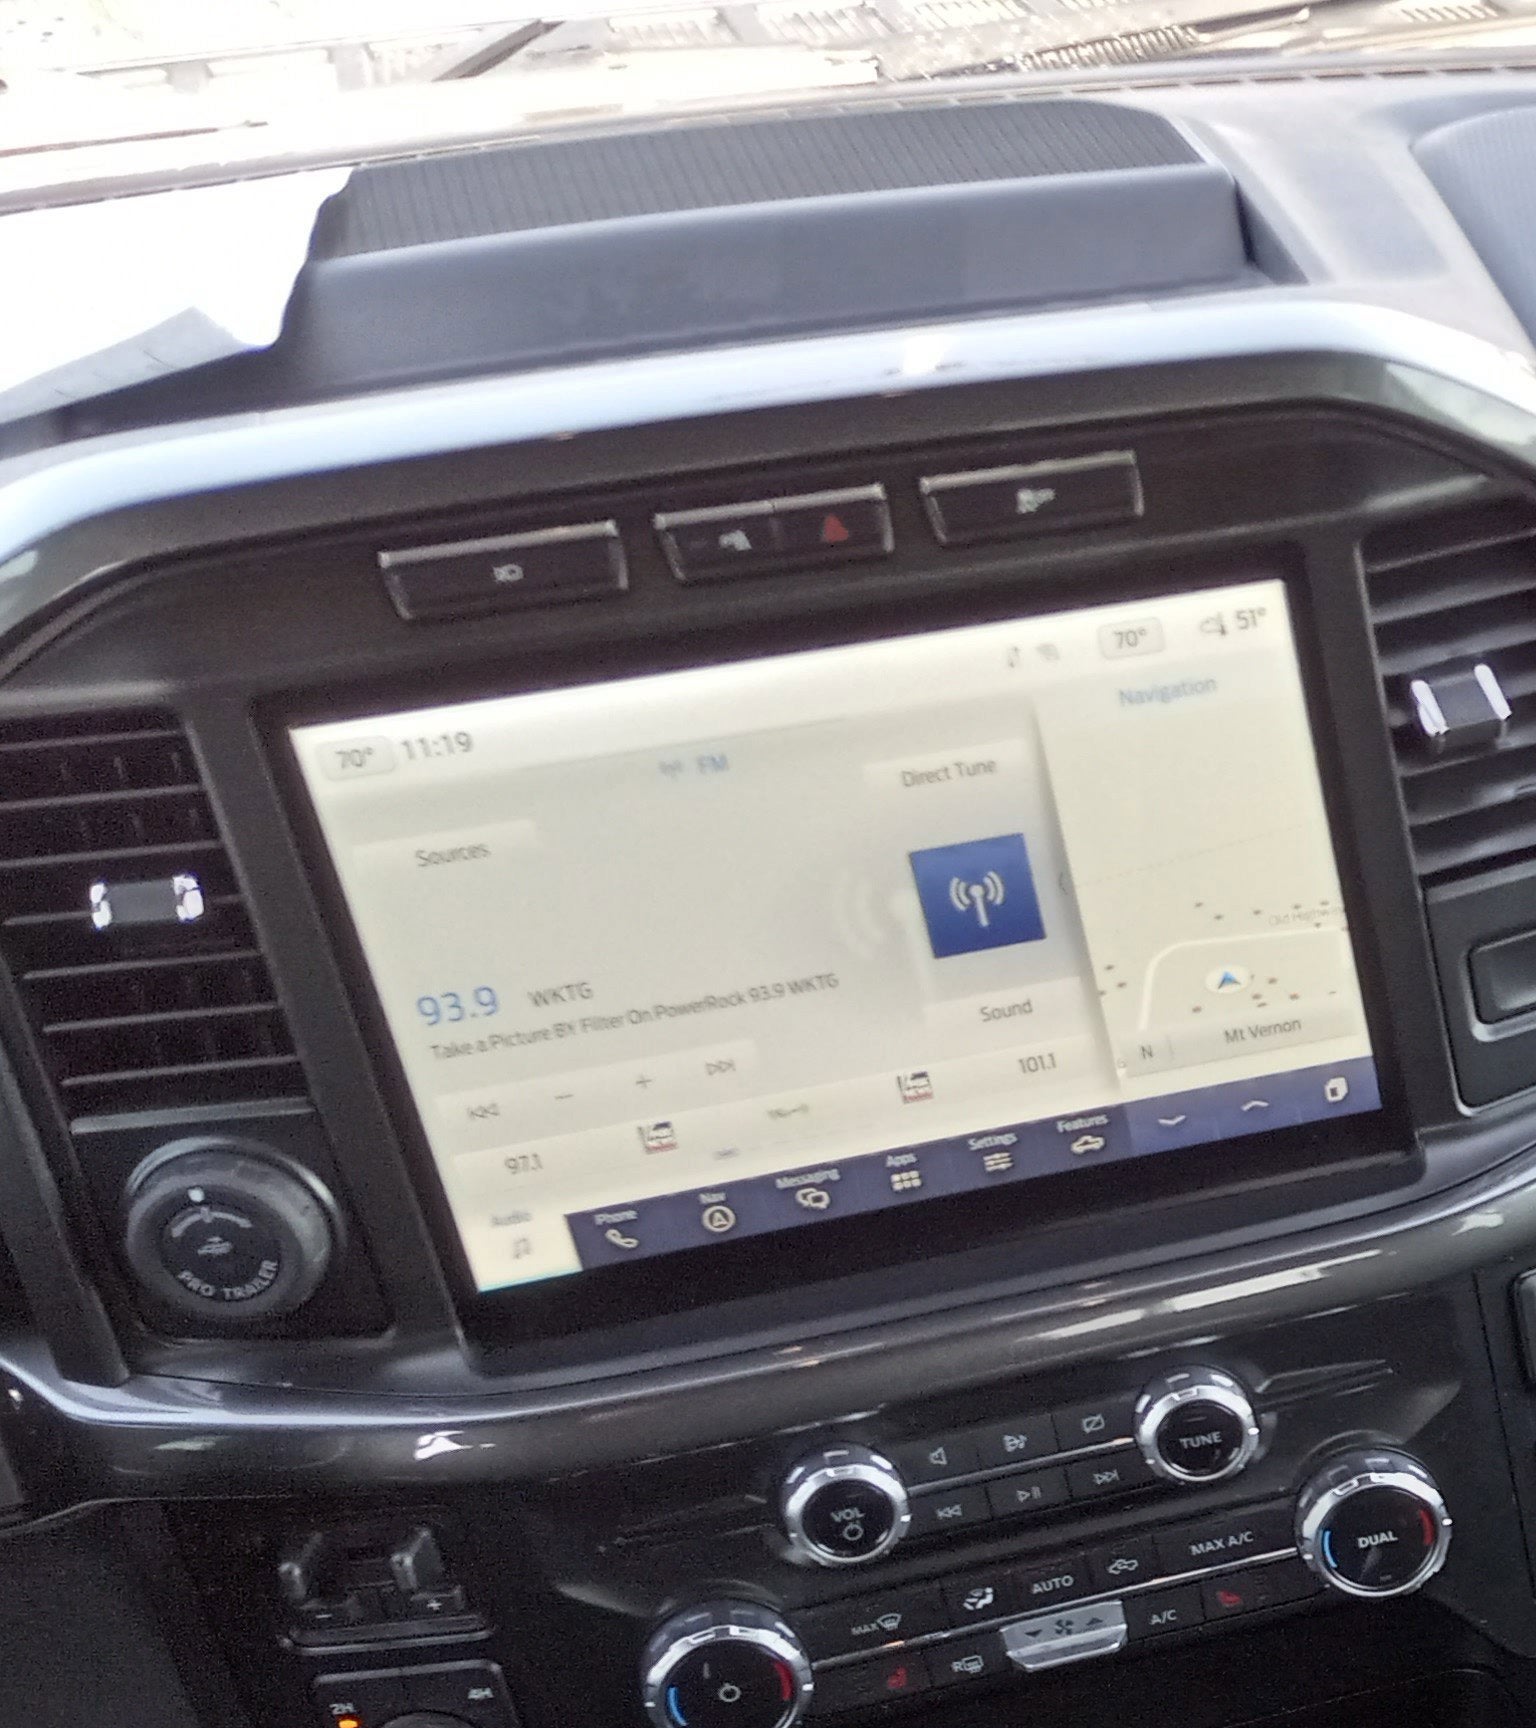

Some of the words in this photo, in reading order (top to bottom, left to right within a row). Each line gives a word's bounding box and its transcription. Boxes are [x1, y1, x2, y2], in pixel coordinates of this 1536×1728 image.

[1235, 606, 1267, 630] 51°
[1113, 626, 1148, 649] 70°
[1117, 675, 1218, 707] Navigation
[401, 730, 474, 763] 11:19
[901, 766, 953, 789] Direct
[954, 757, 998, 780] Tune
[414, 841, 492, 867] Sources
[527, 981, 595, 1007] WKTG
[748, 981, 787, 1002] 93.9
[786, 971, 840, 997] WKTG
[415, 985, 500, 1026] 93.9
[979, 999, 1034, 1024] Sound
[1223, 1025, 1247, 1046] Mt
[1248, 1017, 1303, 1041] Vernon
[1139, 1043, 1155, 1061] N
[1057, 1113, 1109, 1133] Features
[1179, 1430, 1223, 1450] TUNE
[830, 1508, 866, 1523] VOL
[1190, 1538, 1226, 1556] MAX
[1227, 1531, 1255, 1548] A/C
[1357, 1530, 1399, 1549] DUAL
[1031, 1574, 1074, 1594] AUTO
[1150, 1609, 1178, 1626] A/C
